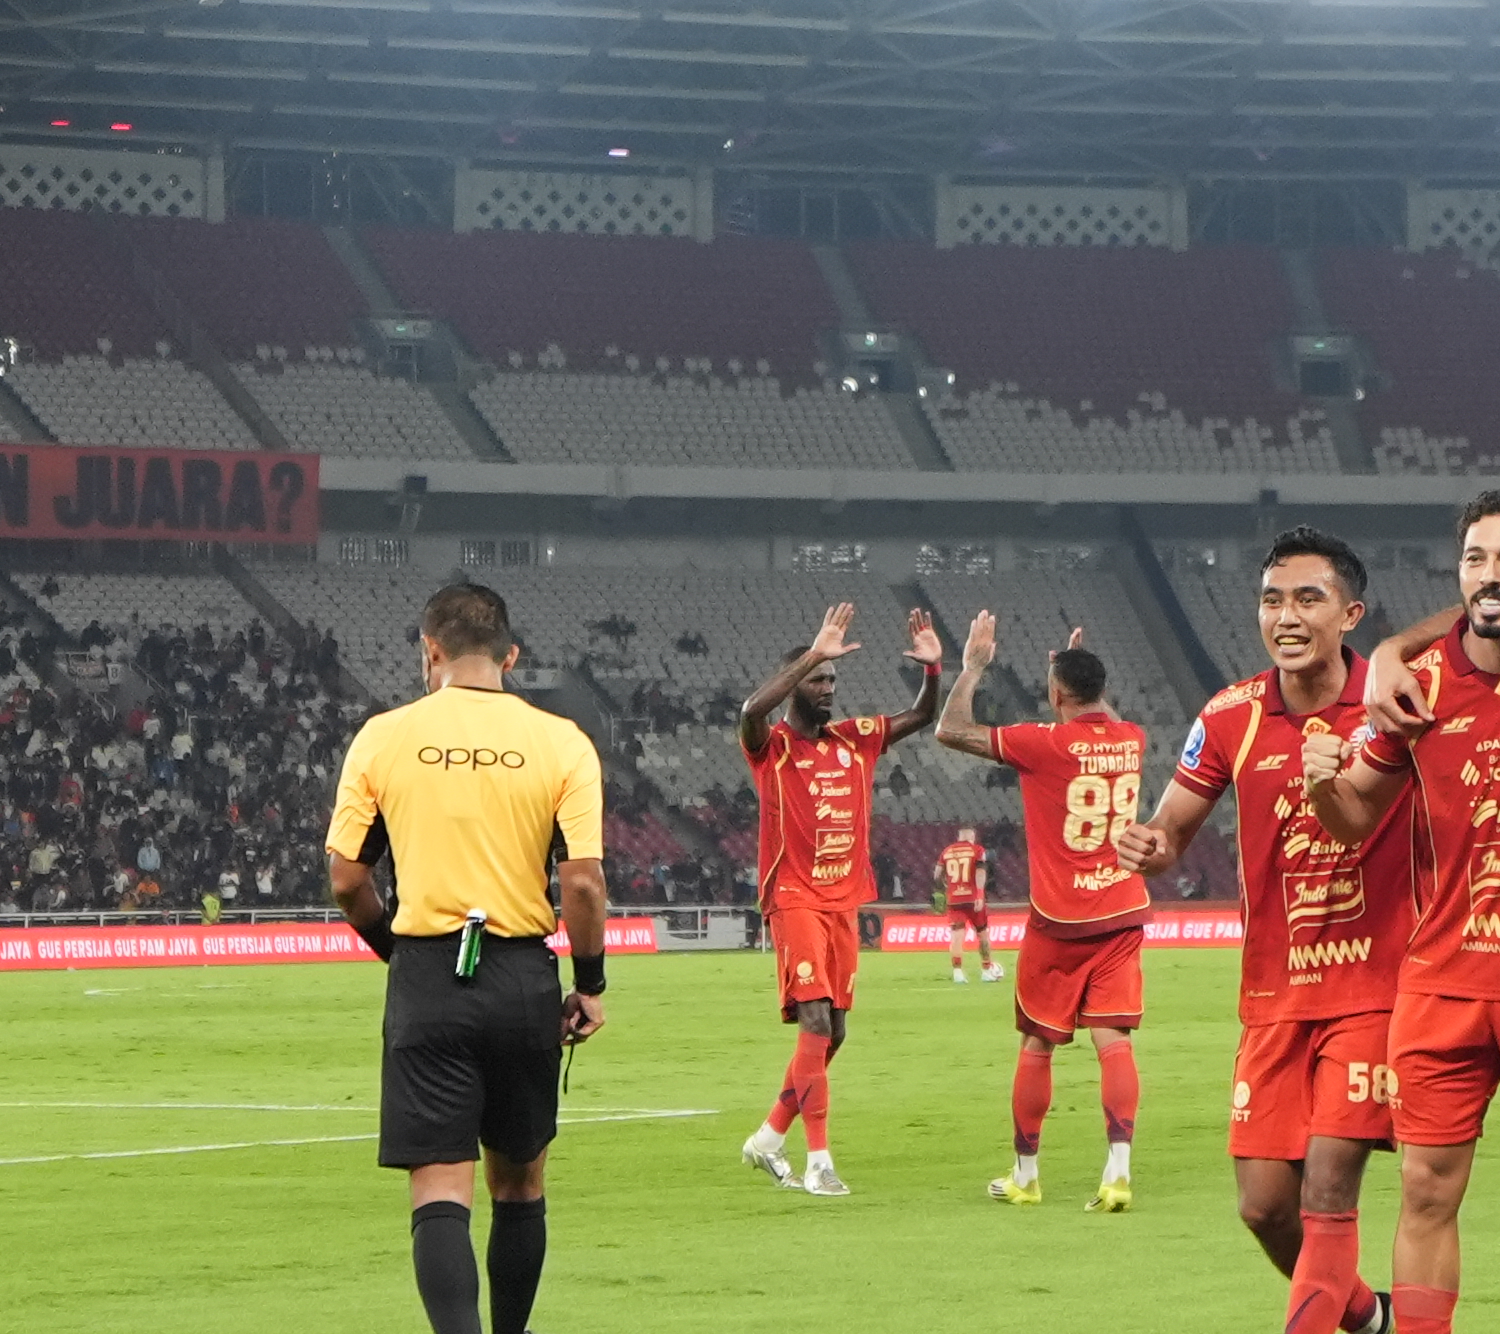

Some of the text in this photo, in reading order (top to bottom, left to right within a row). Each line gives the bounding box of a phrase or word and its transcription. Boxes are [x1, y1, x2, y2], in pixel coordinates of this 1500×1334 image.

[53, 454, 306, 535] JUARA?
[1093, 740, 1140, 755] HYUNDA
[418, 746, 525, 771] oppo
[1077, 753, 1140, 775] TUBARÃO
[1062, 773, 1141, 853] 88
[946, 857, 970, 884] 97
[1073, 868, 1133, 892] Minale
[624, 929, 652, 945] JAYA
[887, 927, 919, 943] GUE
[1183, 923, 1212, 939] GUE
[0, 941, 32, 959] JAYA
[38, 938, 197, 958] GUE PERSIJA GUE PAM JAYA
[203, 937, 226, 955] GUE
[225, 936, 272, 954] PERSIJA
[274, 936, 297, 953] GUE
[297, 936, 322, 952] PAM
[324, 935, 352, 952] JAYA
[1347, 1062, 1389, 1104] 58
[1231, 1109, 1252, 1123] TCT
